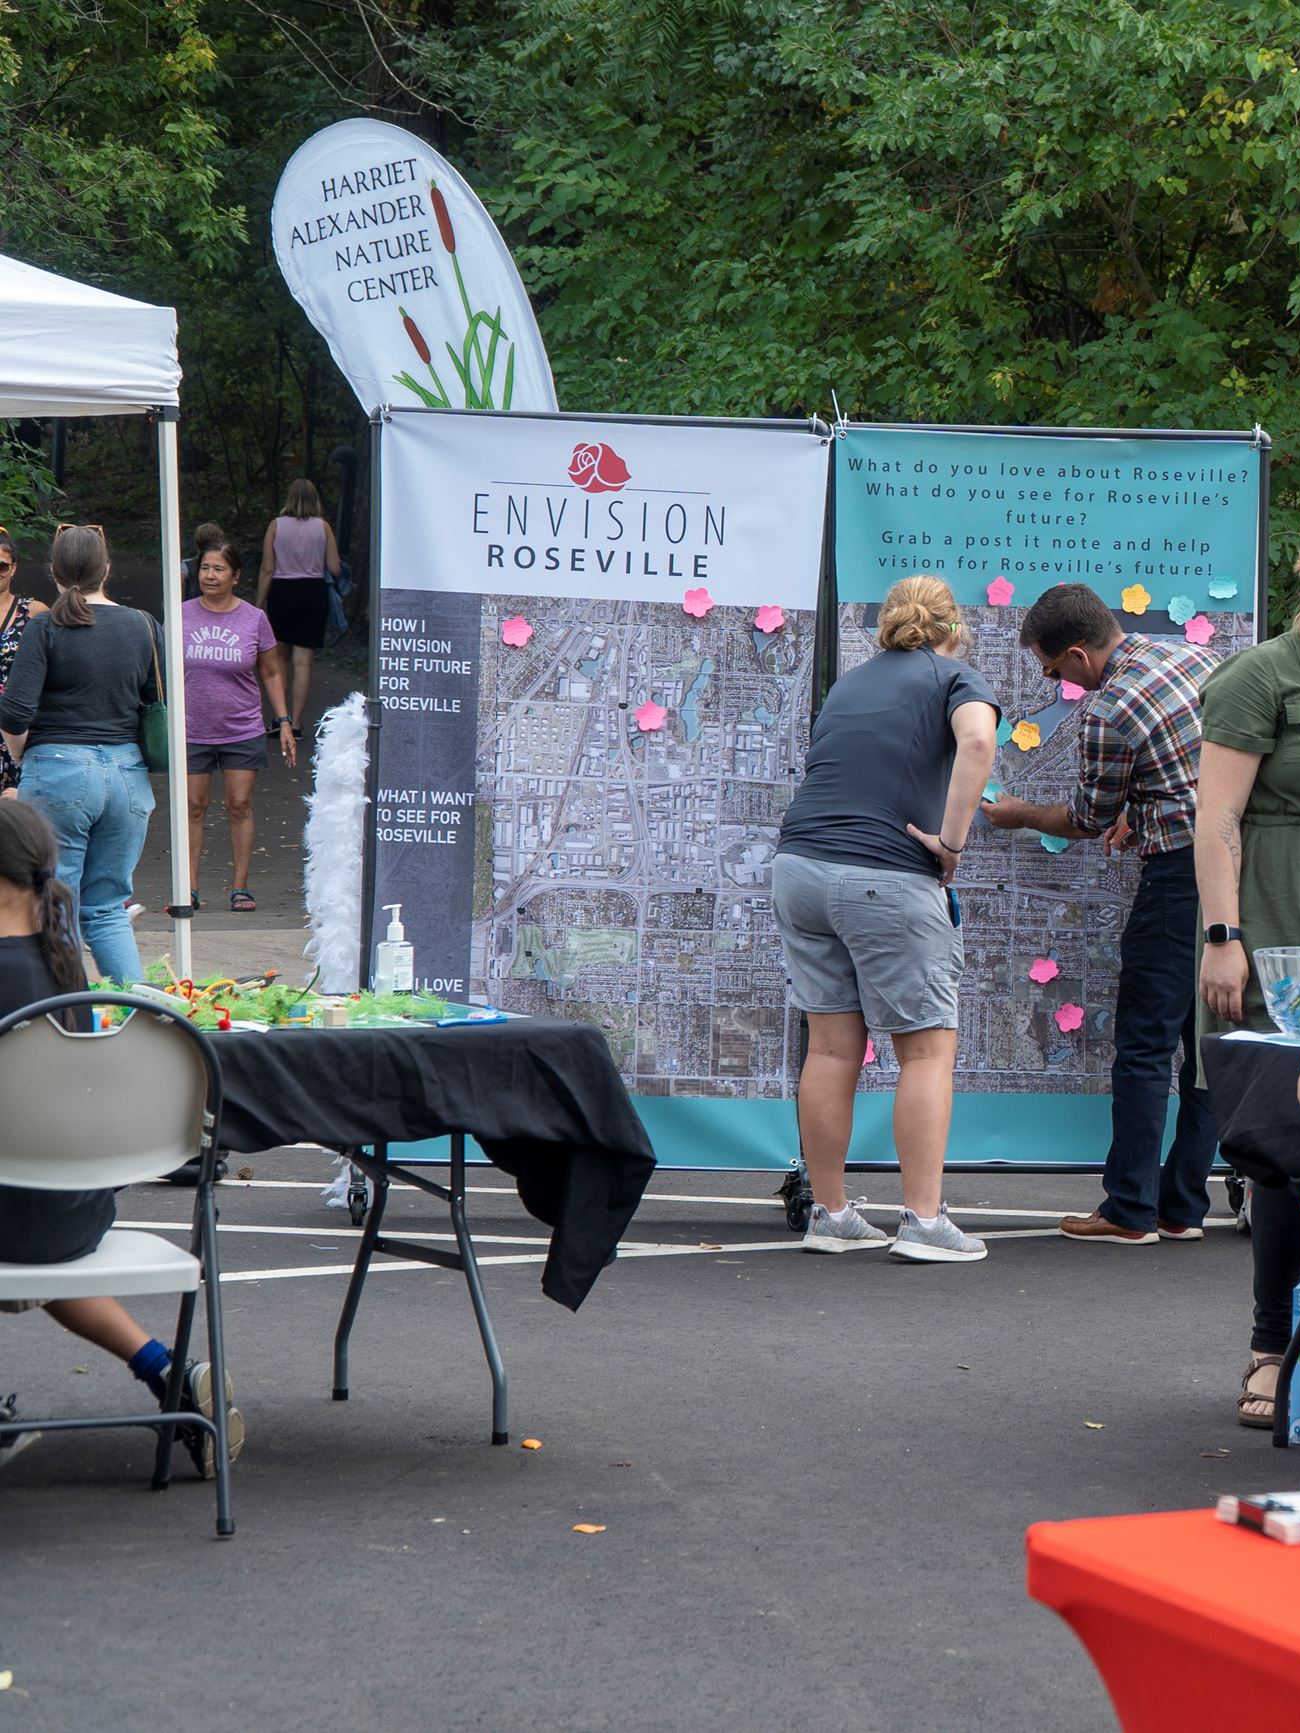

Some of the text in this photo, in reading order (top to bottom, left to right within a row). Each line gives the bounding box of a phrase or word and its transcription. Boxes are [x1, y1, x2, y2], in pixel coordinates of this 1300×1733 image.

[321, 158, 417, 202] HARRIET
[290, 194, 426, 249] ALEXANDER
[335, 229, 432, 271] NATURE
[347, 265, 439, 303] CENTER
[848, 458, 1249, 484] What do you love about Roseville?
[866, 482, 1230, 506] What do you see for Roseville's
[473, 493, 726, 546] ENVISION
[1006, 510, 1087, 526] future?
[882, 531, 1211, 556] Grab a post it note and help
[488, 544, 709, 578] ROSEVILLE
[878, 554, 1213, 577] vision for Roseville's future!
[381, 618, 425, 633] HOW I
[190, 625, 240, 647] UNDER
[380, 637, 451, 654] ENVISION
[186, 644, 242, 663] ARMOUR
[379, 657, 471, 675] THE FUTURE
[379, 676, 410, 691] FOR
[379, 696, 461, 713] ROSEVILLE
[377, 789, 475, 806] WHAT I WANT
[396, 809, 426, 823] SEE
[430, 810, 461, 825] FOR
[376, 828, 457, 844] ROSEVILLE
[415, 977, 464, 993] I LOVE
